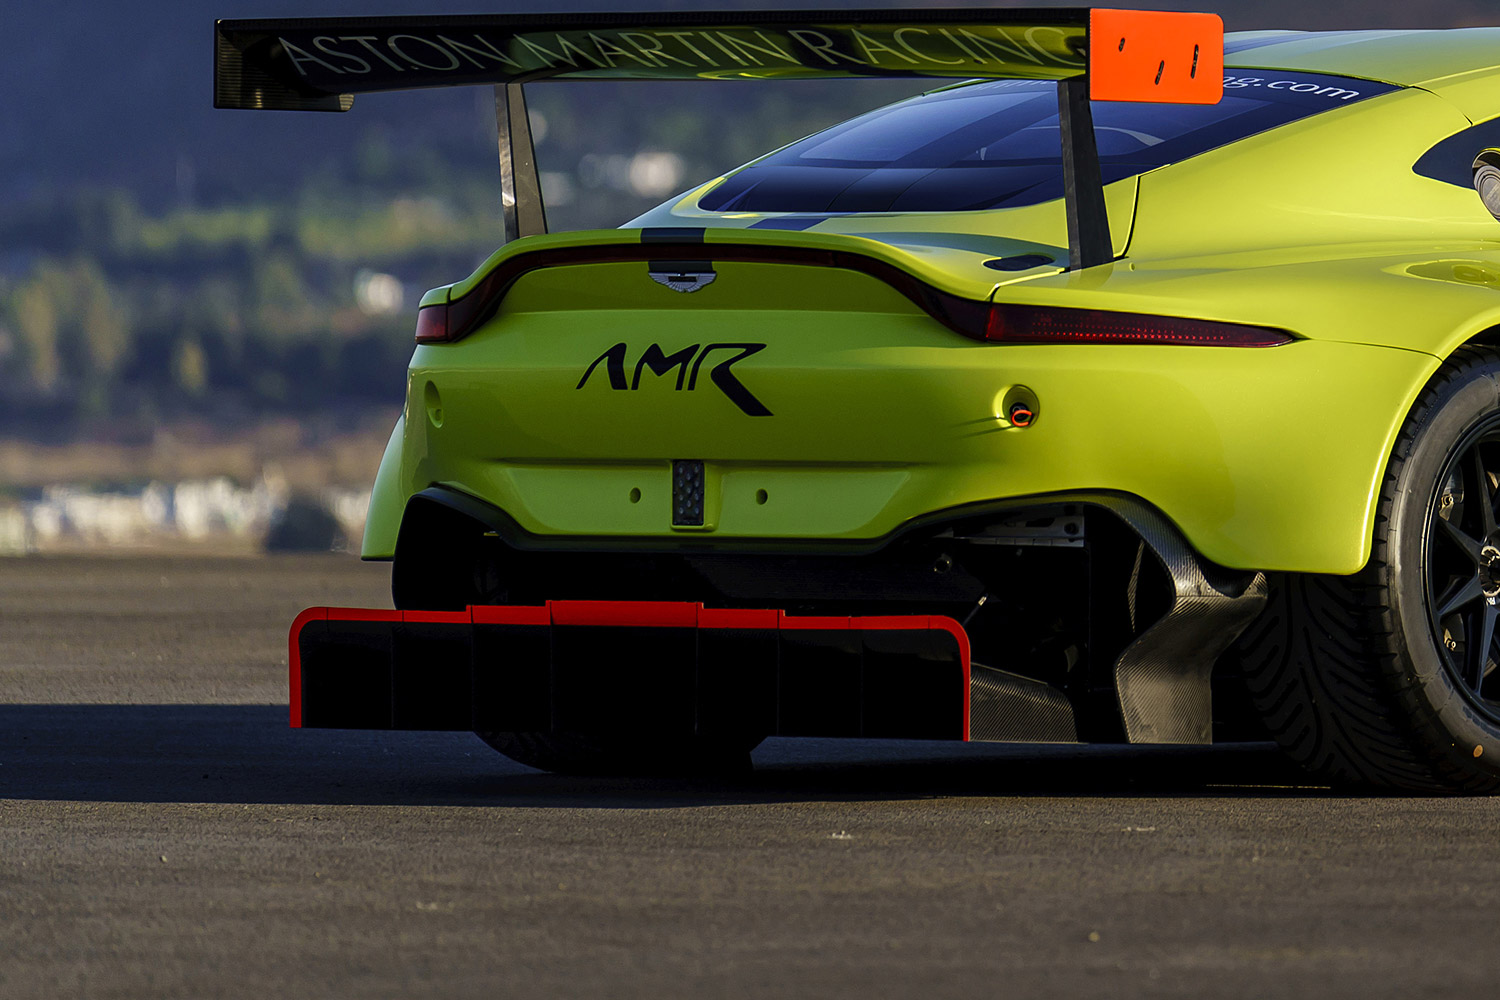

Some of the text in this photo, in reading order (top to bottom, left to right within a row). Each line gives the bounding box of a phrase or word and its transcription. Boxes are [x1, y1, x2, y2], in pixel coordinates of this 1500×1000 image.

[278, 34, 522, 76] ASTON
[513, 31, 803, 68] MARTIN
[576, 342, 774, 417] AMR
